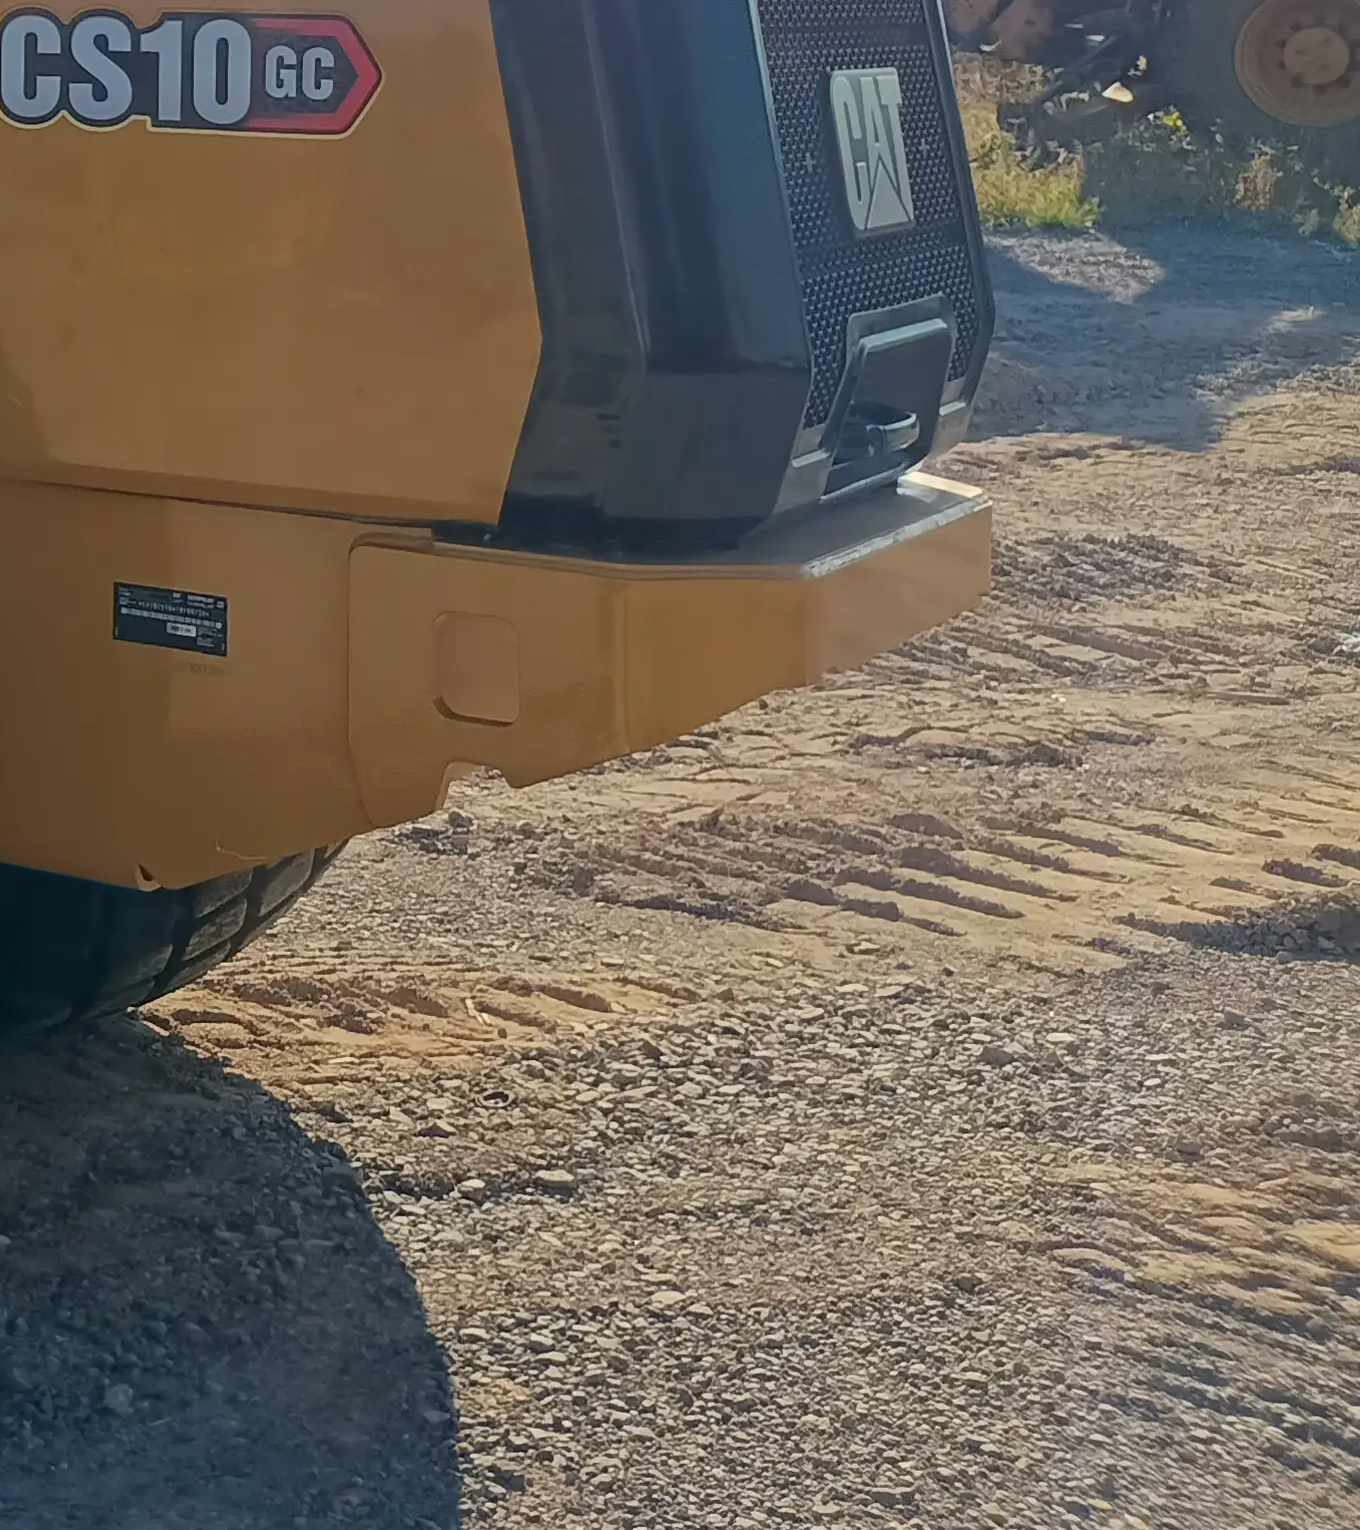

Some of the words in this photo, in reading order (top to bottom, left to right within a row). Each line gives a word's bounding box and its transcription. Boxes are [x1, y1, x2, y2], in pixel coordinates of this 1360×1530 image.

[0, 13, 252, 126] CS10
[264, 46, 336, 101] GC
[831, 74, 915, 231] CAT
